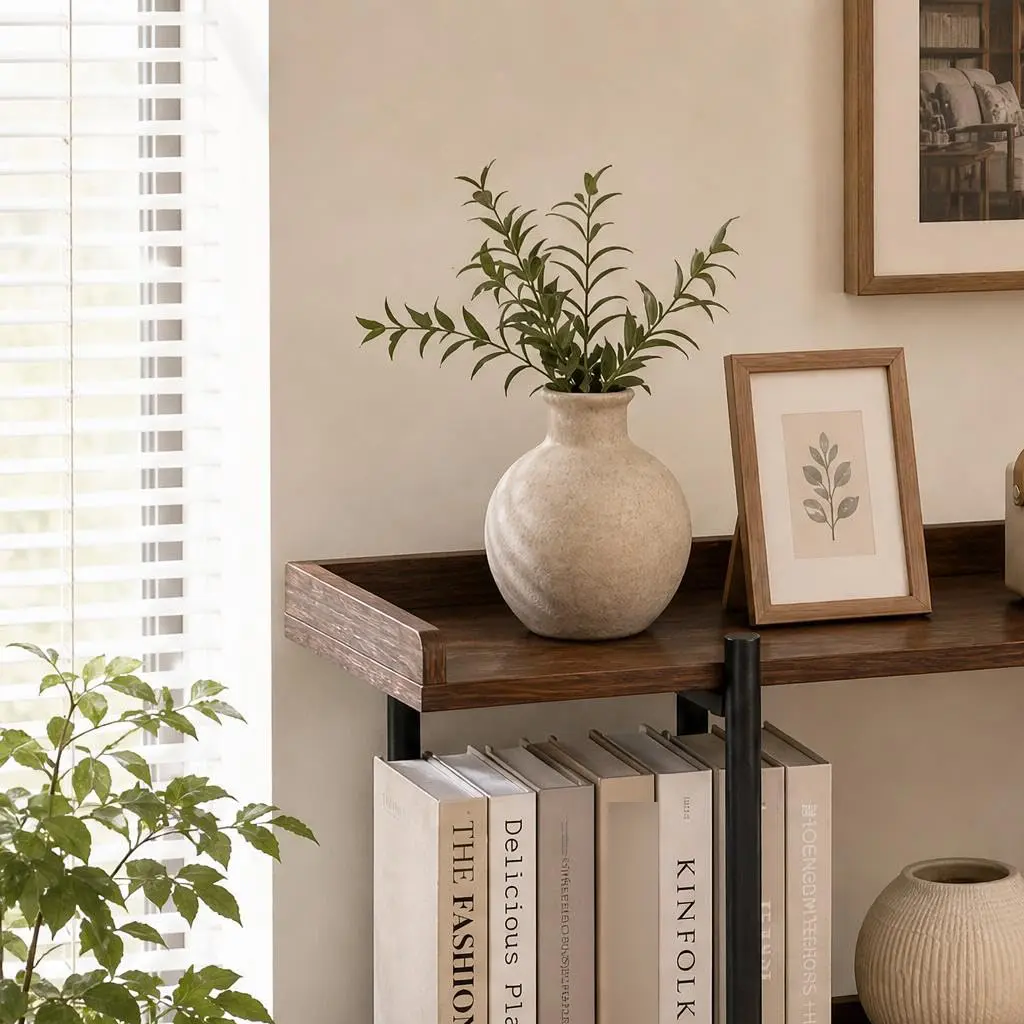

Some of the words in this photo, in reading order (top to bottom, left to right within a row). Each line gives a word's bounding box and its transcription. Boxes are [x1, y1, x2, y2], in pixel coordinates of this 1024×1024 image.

[451, 819, 475, 884] THE
[504, 818, 524, 965] Delicious
[675, 857, 697, 1021] KINFOLK
